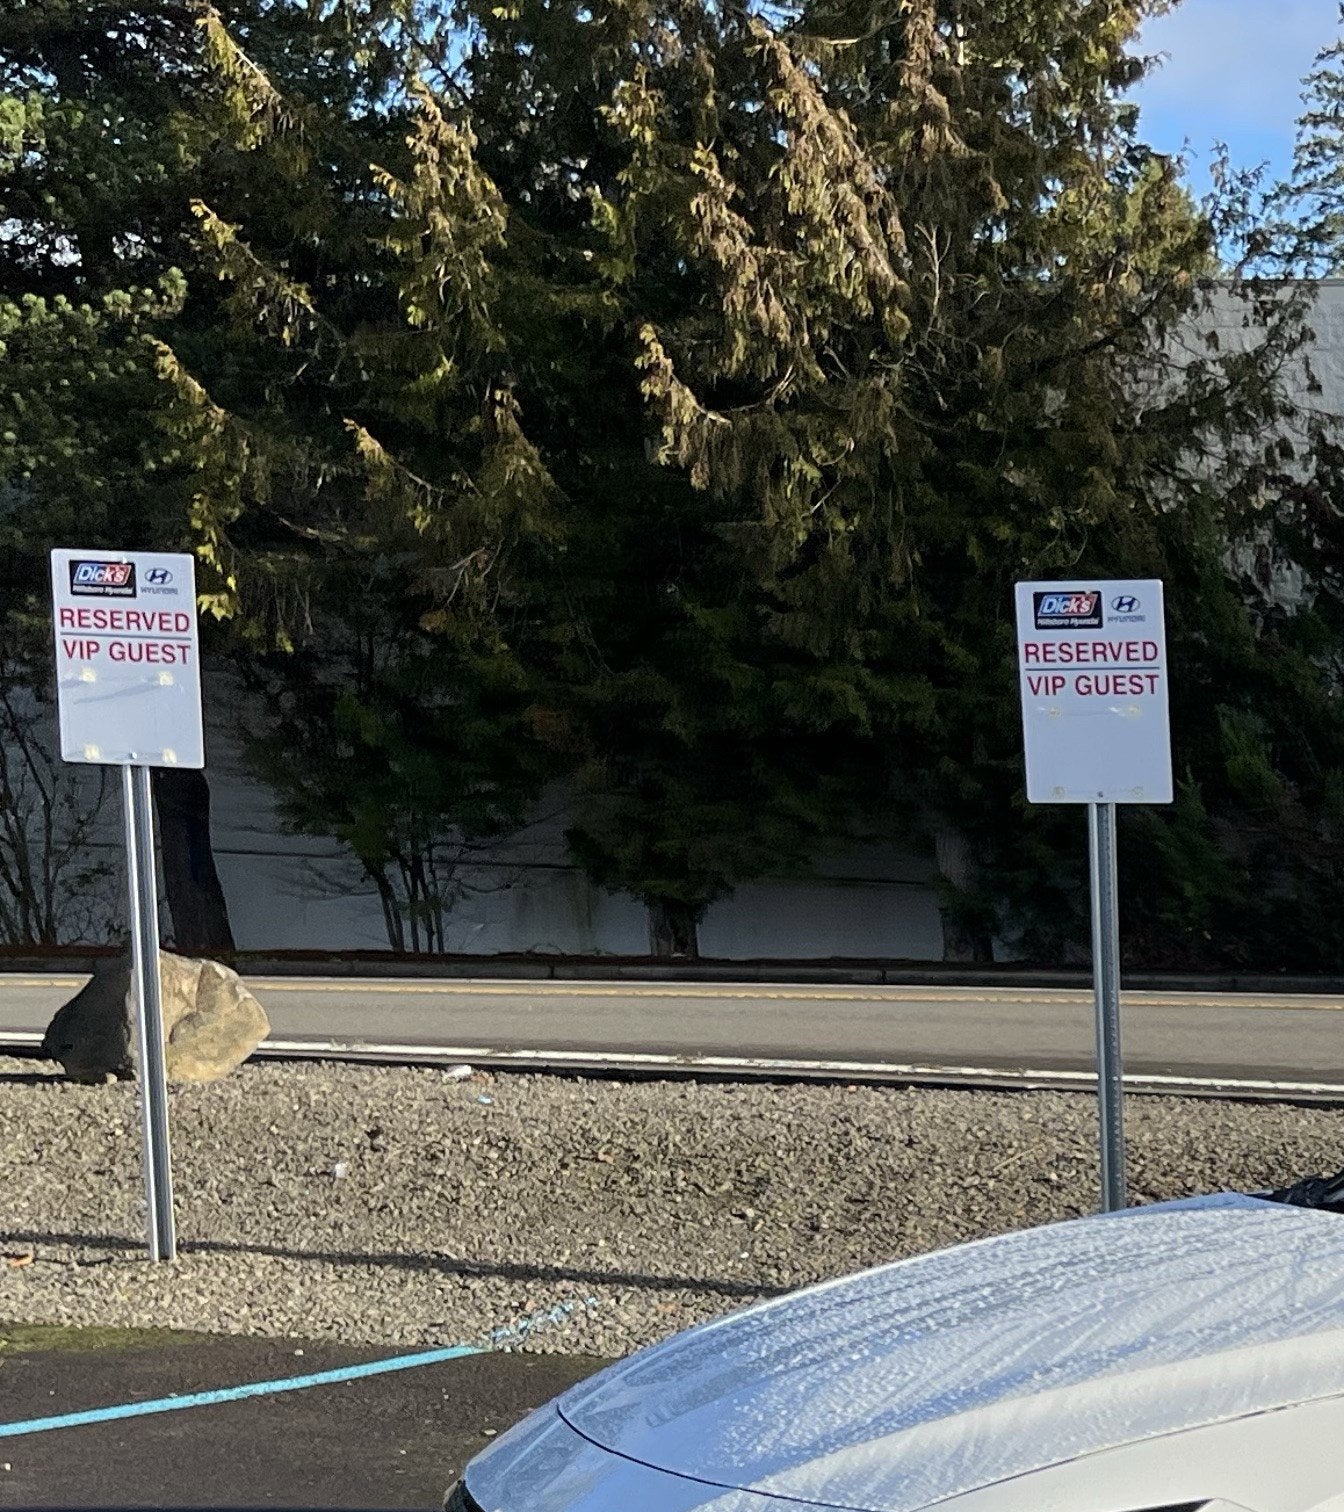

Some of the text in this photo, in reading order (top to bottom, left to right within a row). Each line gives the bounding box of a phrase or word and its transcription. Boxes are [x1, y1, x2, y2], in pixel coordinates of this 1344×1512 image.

[59, 607, 190, 633] RESERVED
[62, 639, 191, 665] VIP GUEST
[1024, 641, 1158, 663] RESERVED
[1027, 674, 1159, 696] VIP GUEST
